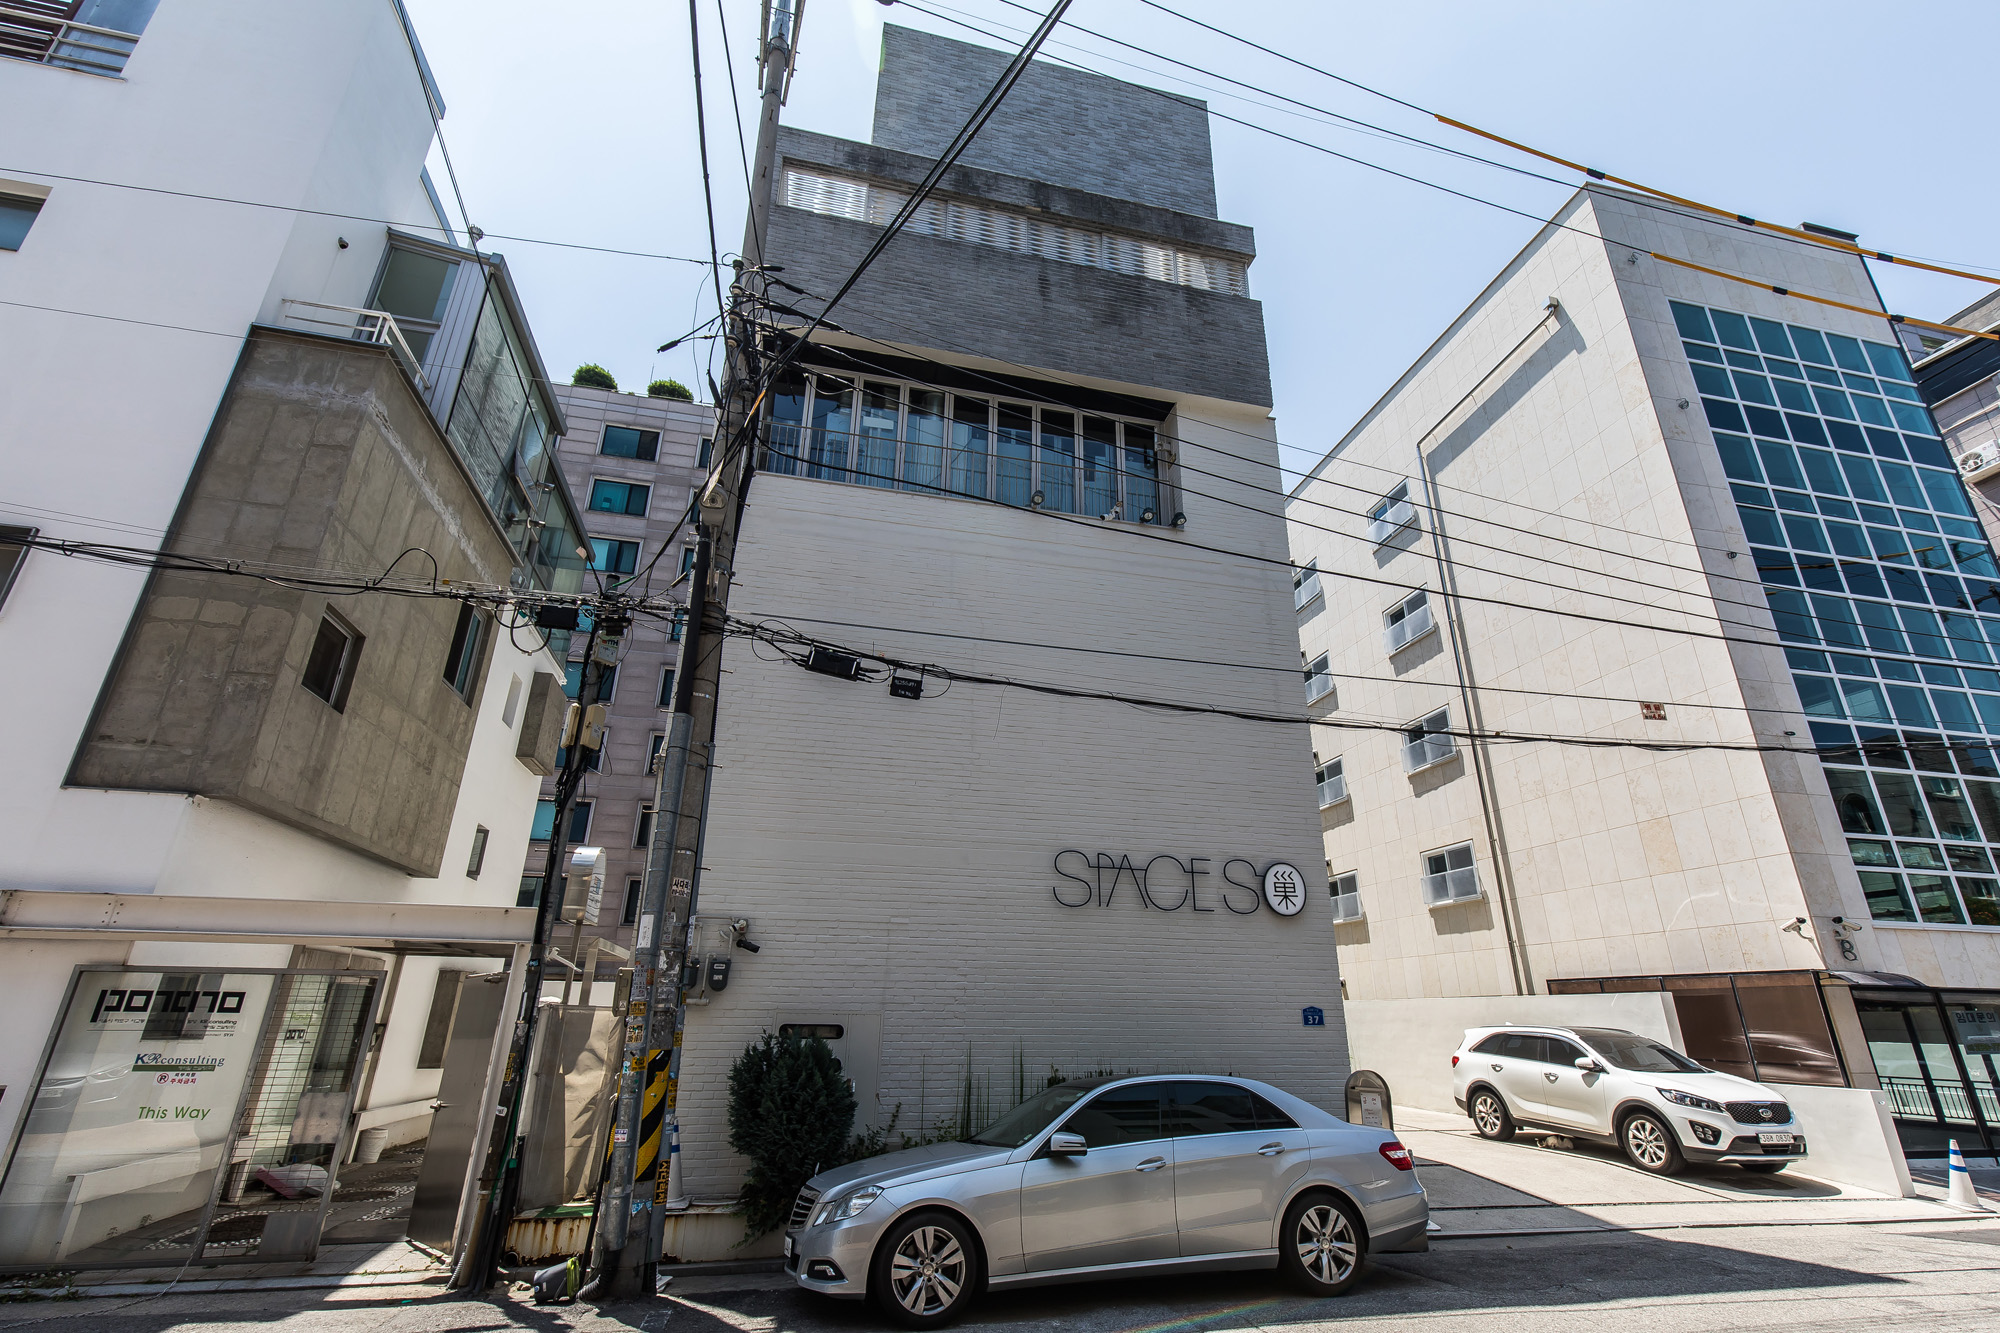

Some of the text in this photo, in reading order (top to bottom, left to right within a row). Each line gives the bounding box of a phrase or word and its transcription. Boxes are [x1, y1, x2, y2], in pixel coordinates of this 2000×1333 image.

[1308, 1015, 1319, 1025] 37
[1956, 1012, 1996, 1023] 임대문의
[139, 1106, 211, 1120] This Way
